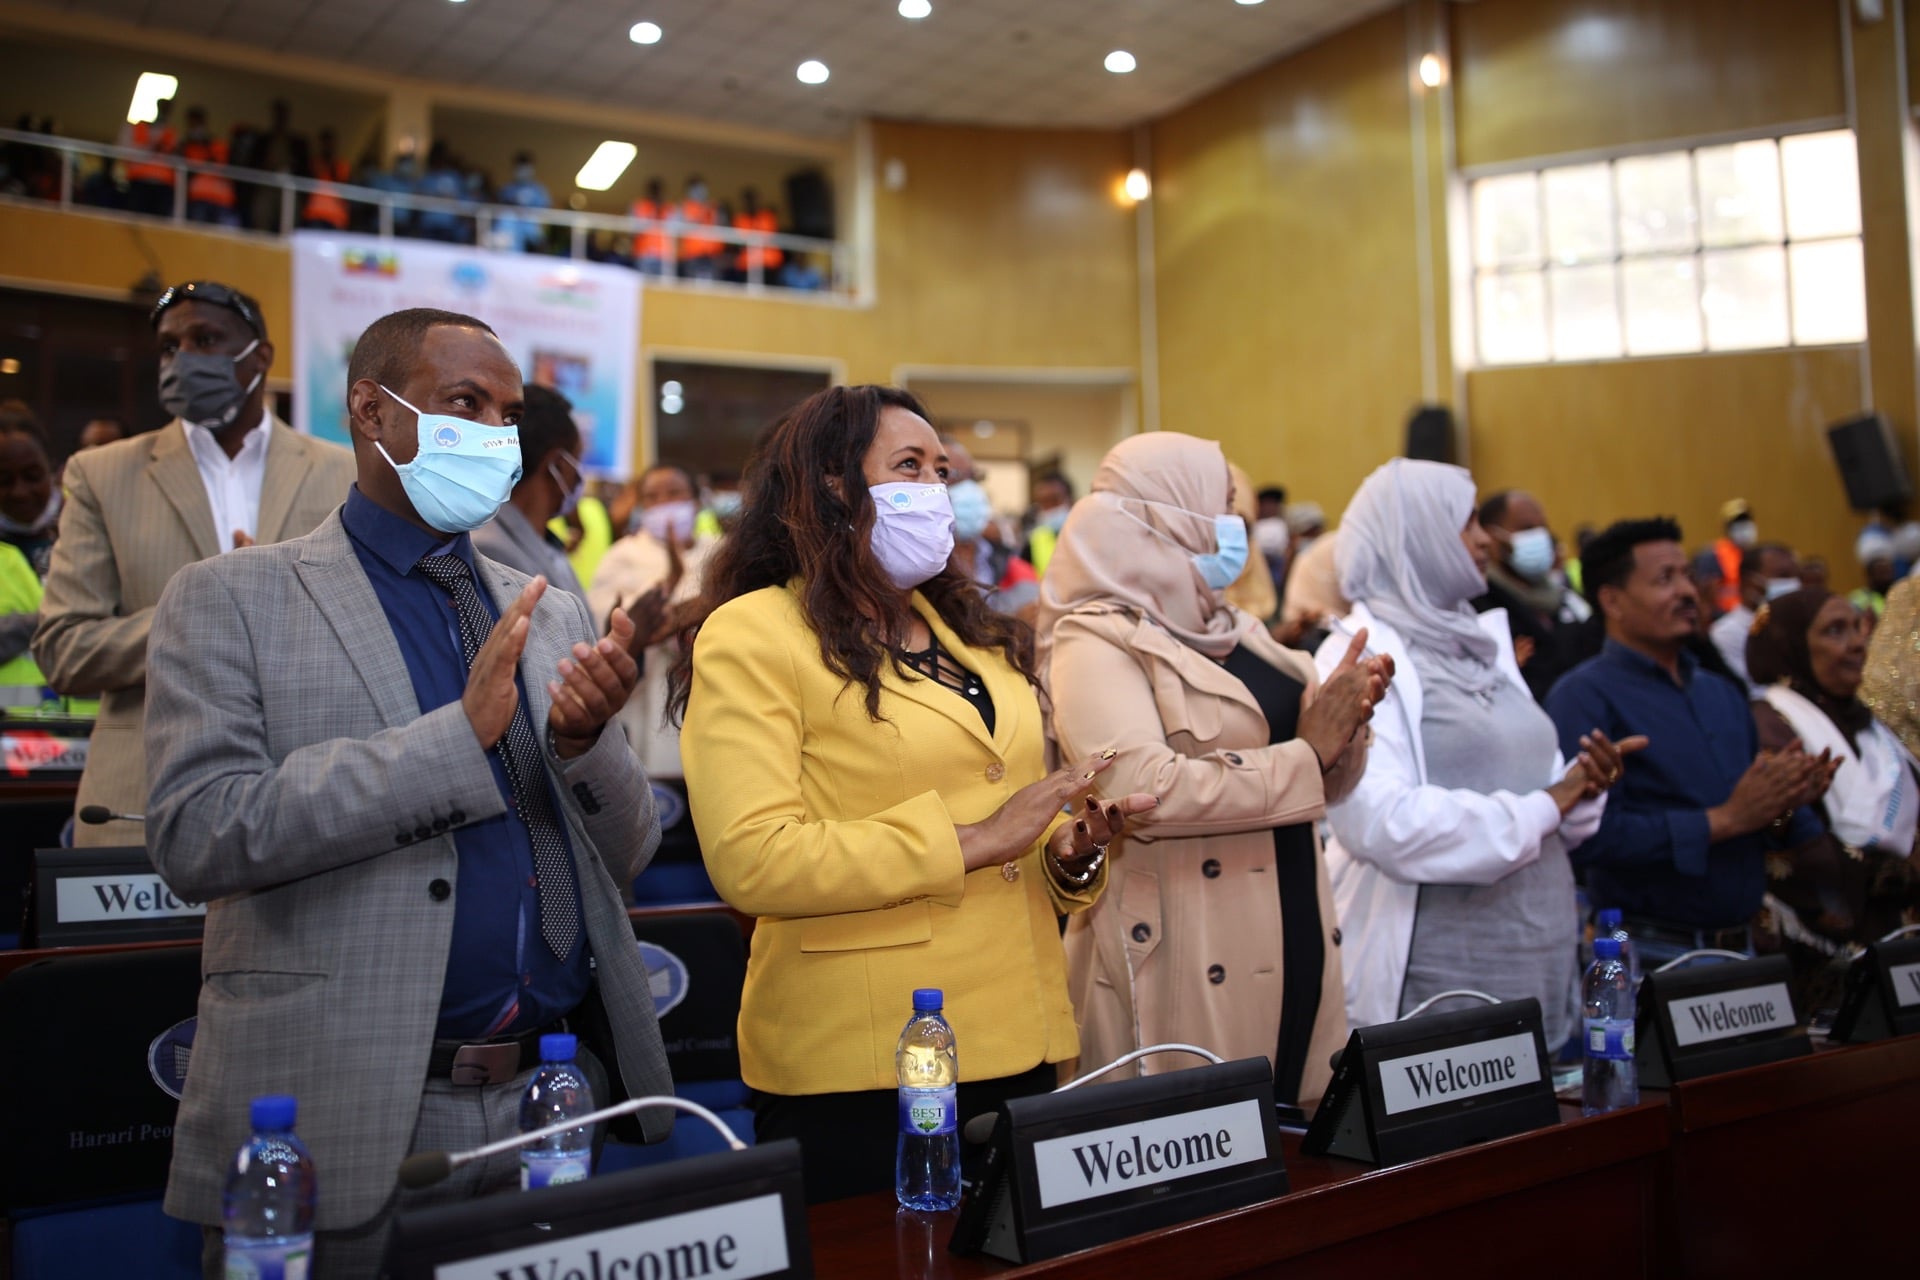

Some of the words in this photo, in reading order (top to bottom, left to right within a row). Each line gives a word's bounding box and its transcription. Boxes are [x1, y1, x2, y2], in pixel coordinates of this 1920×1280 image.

[1688, 1001, 1777, 1034] Welcome
[1404, 1055, 1517, 1099] Welcome
[912, 1107, 944, 1118] BEST
[69, 1125, 135, 1149] Harari
[1072, 1128, 1233, 1188] Welcome
